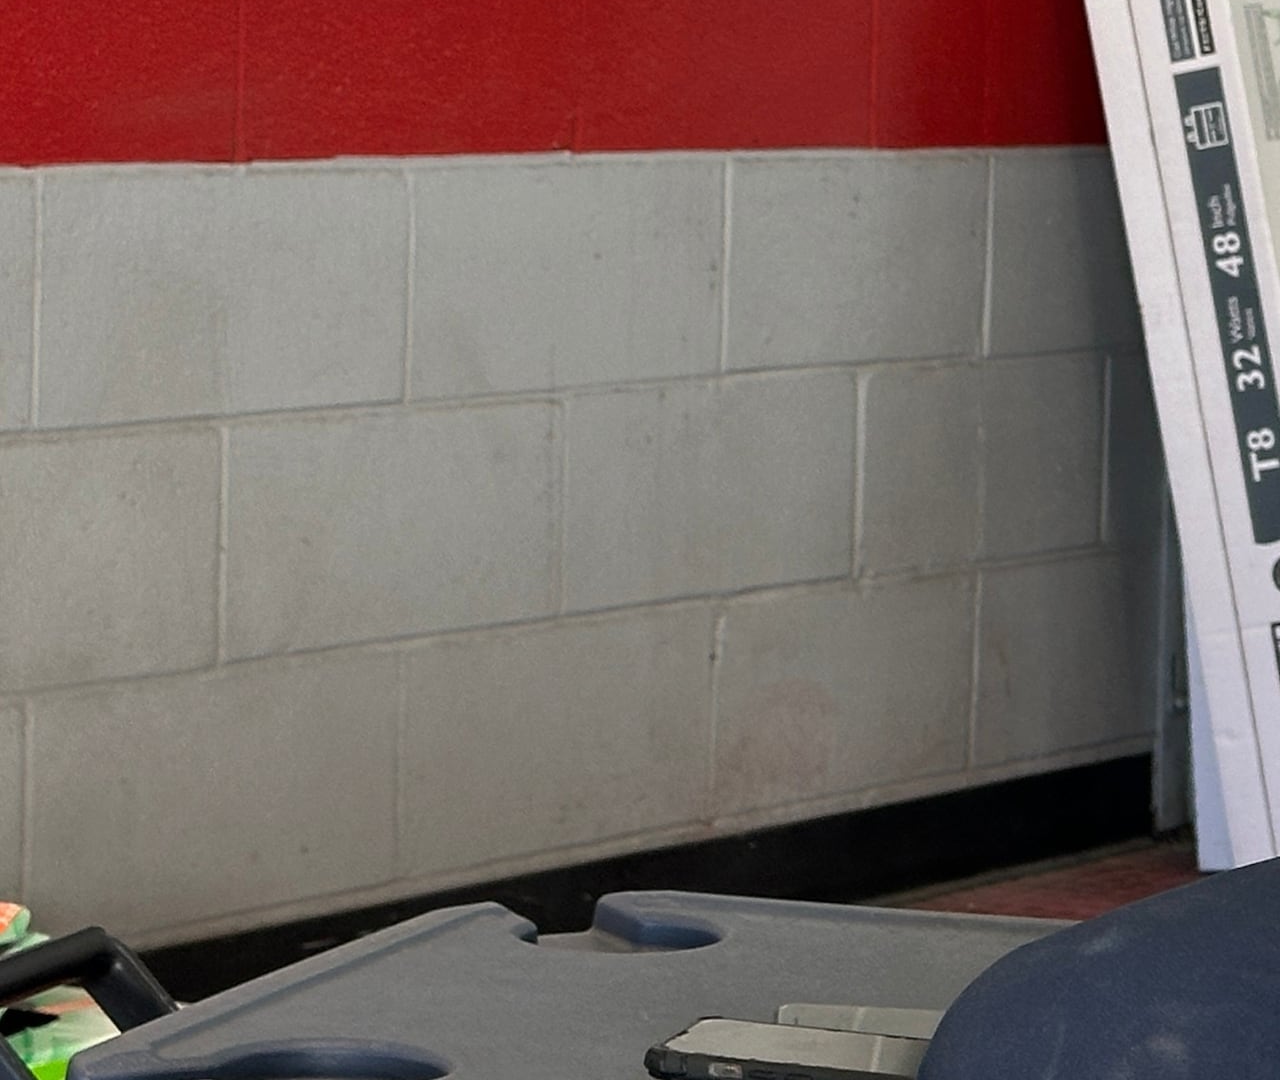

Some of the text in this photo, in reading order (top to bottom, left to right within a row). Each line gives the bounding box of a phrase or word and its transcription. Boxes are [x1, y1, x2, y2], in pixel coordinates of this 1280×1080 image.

[1213, 232, 1244, 277] 48
[1233, 345, 1265, 392] 32
[1247, 427, 1280, 482] T8
